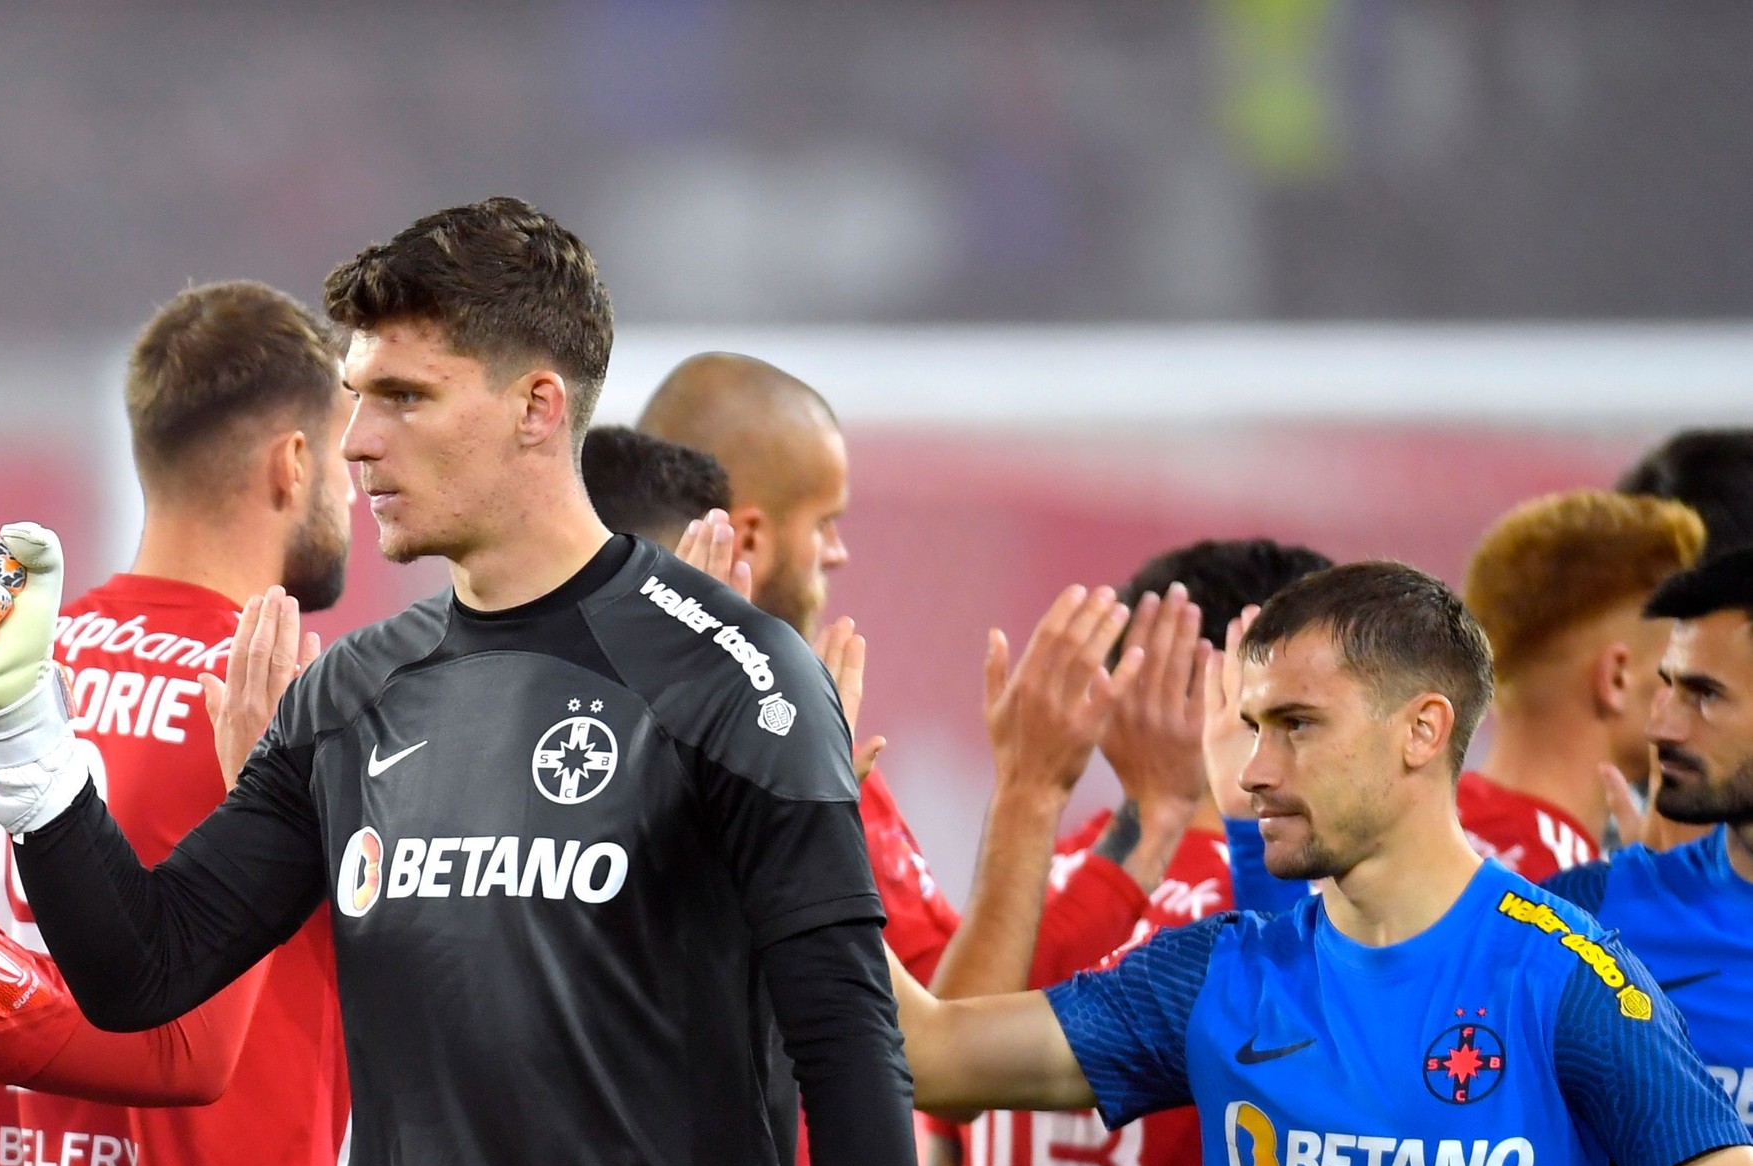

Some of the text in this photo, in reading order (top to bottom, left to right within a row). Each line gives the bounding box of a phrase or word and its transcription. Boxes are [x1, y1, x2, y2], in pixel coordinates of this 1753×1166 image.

[639, 575, 774, 691] walter tosto
[64, 665, 203, 744] ORIE
[387, 836, 629, 904] BETANO
